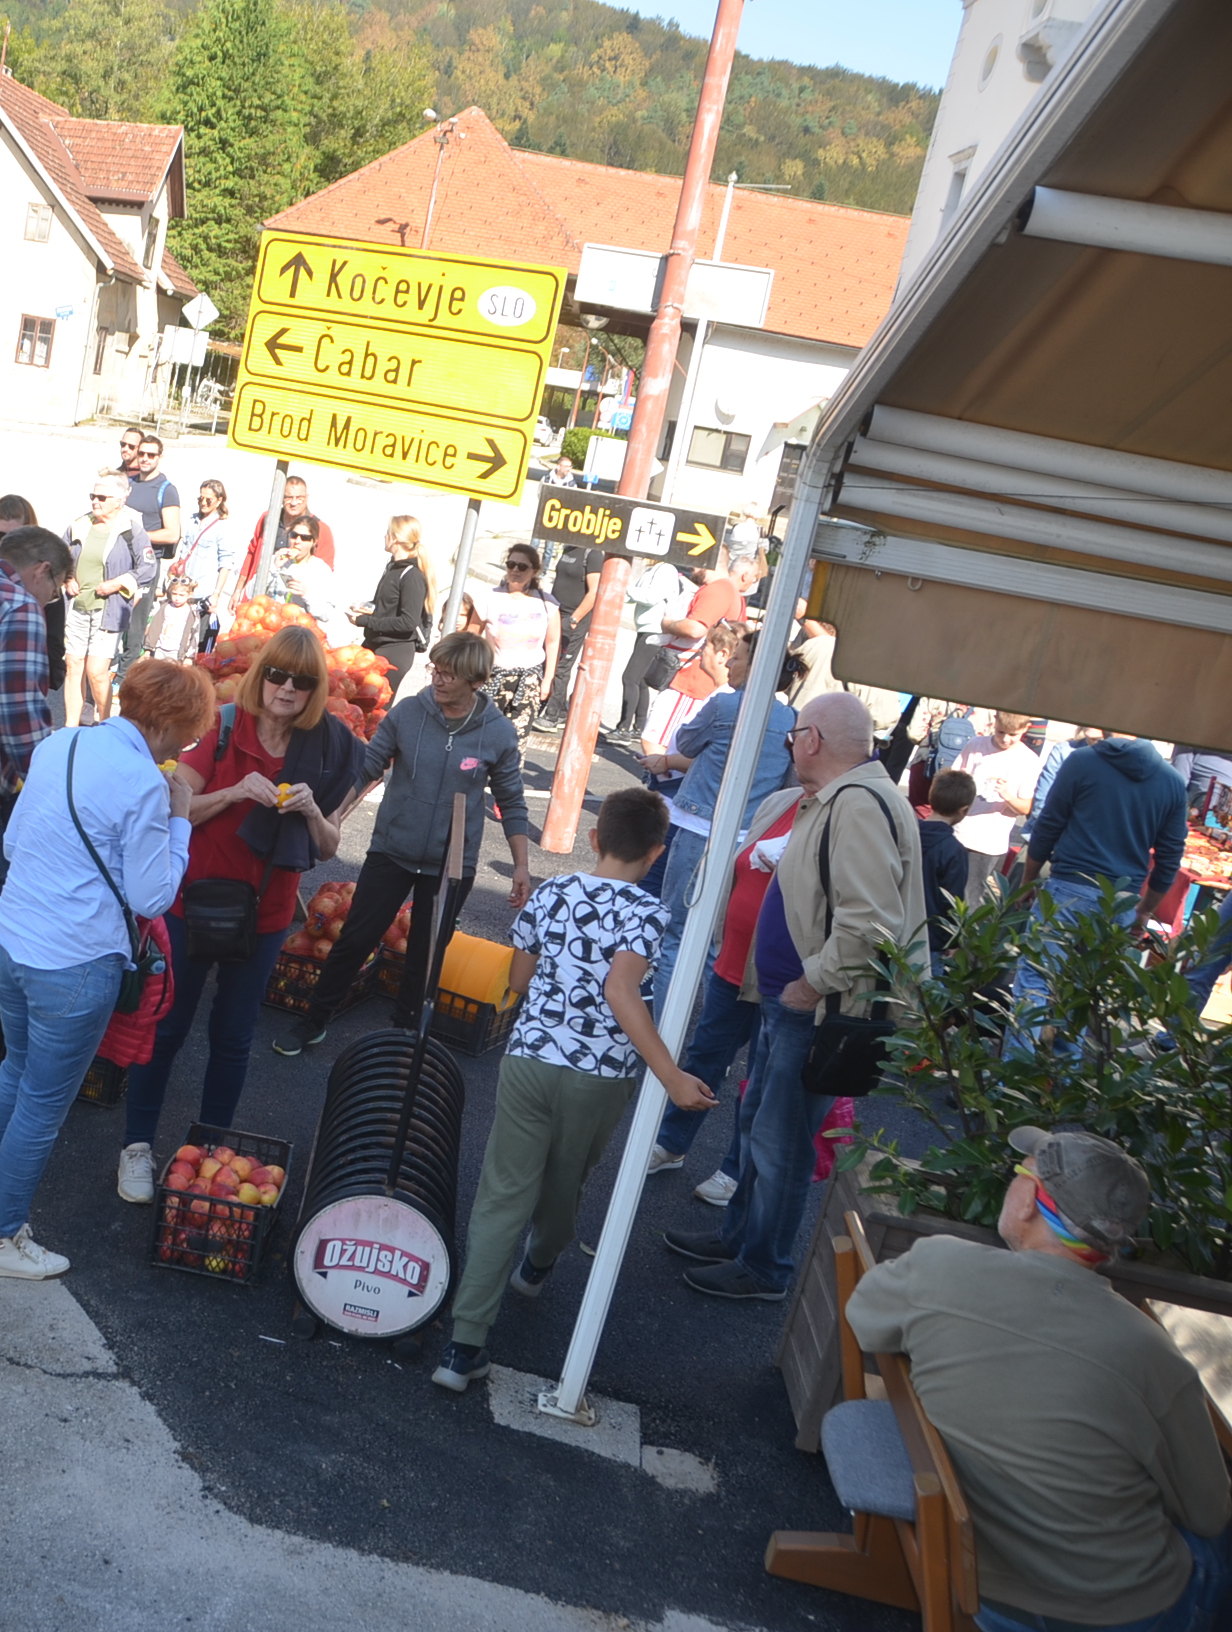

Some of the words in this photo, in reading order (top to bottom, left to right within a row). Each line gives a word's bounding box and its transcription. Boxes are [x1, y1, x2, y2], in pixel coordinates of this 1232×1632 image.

[326, 258, 467, 322] Kočevje
[486, 293, 525, 319] SLO
[314, 325, 423, 388] Čabar
[248, 399, 313, 443] Brod
[327, 413, 458, 470] Moravice
[542, 498, 623, 543] Groblje
[323, 1239, 421, 1286] Ožujsko
